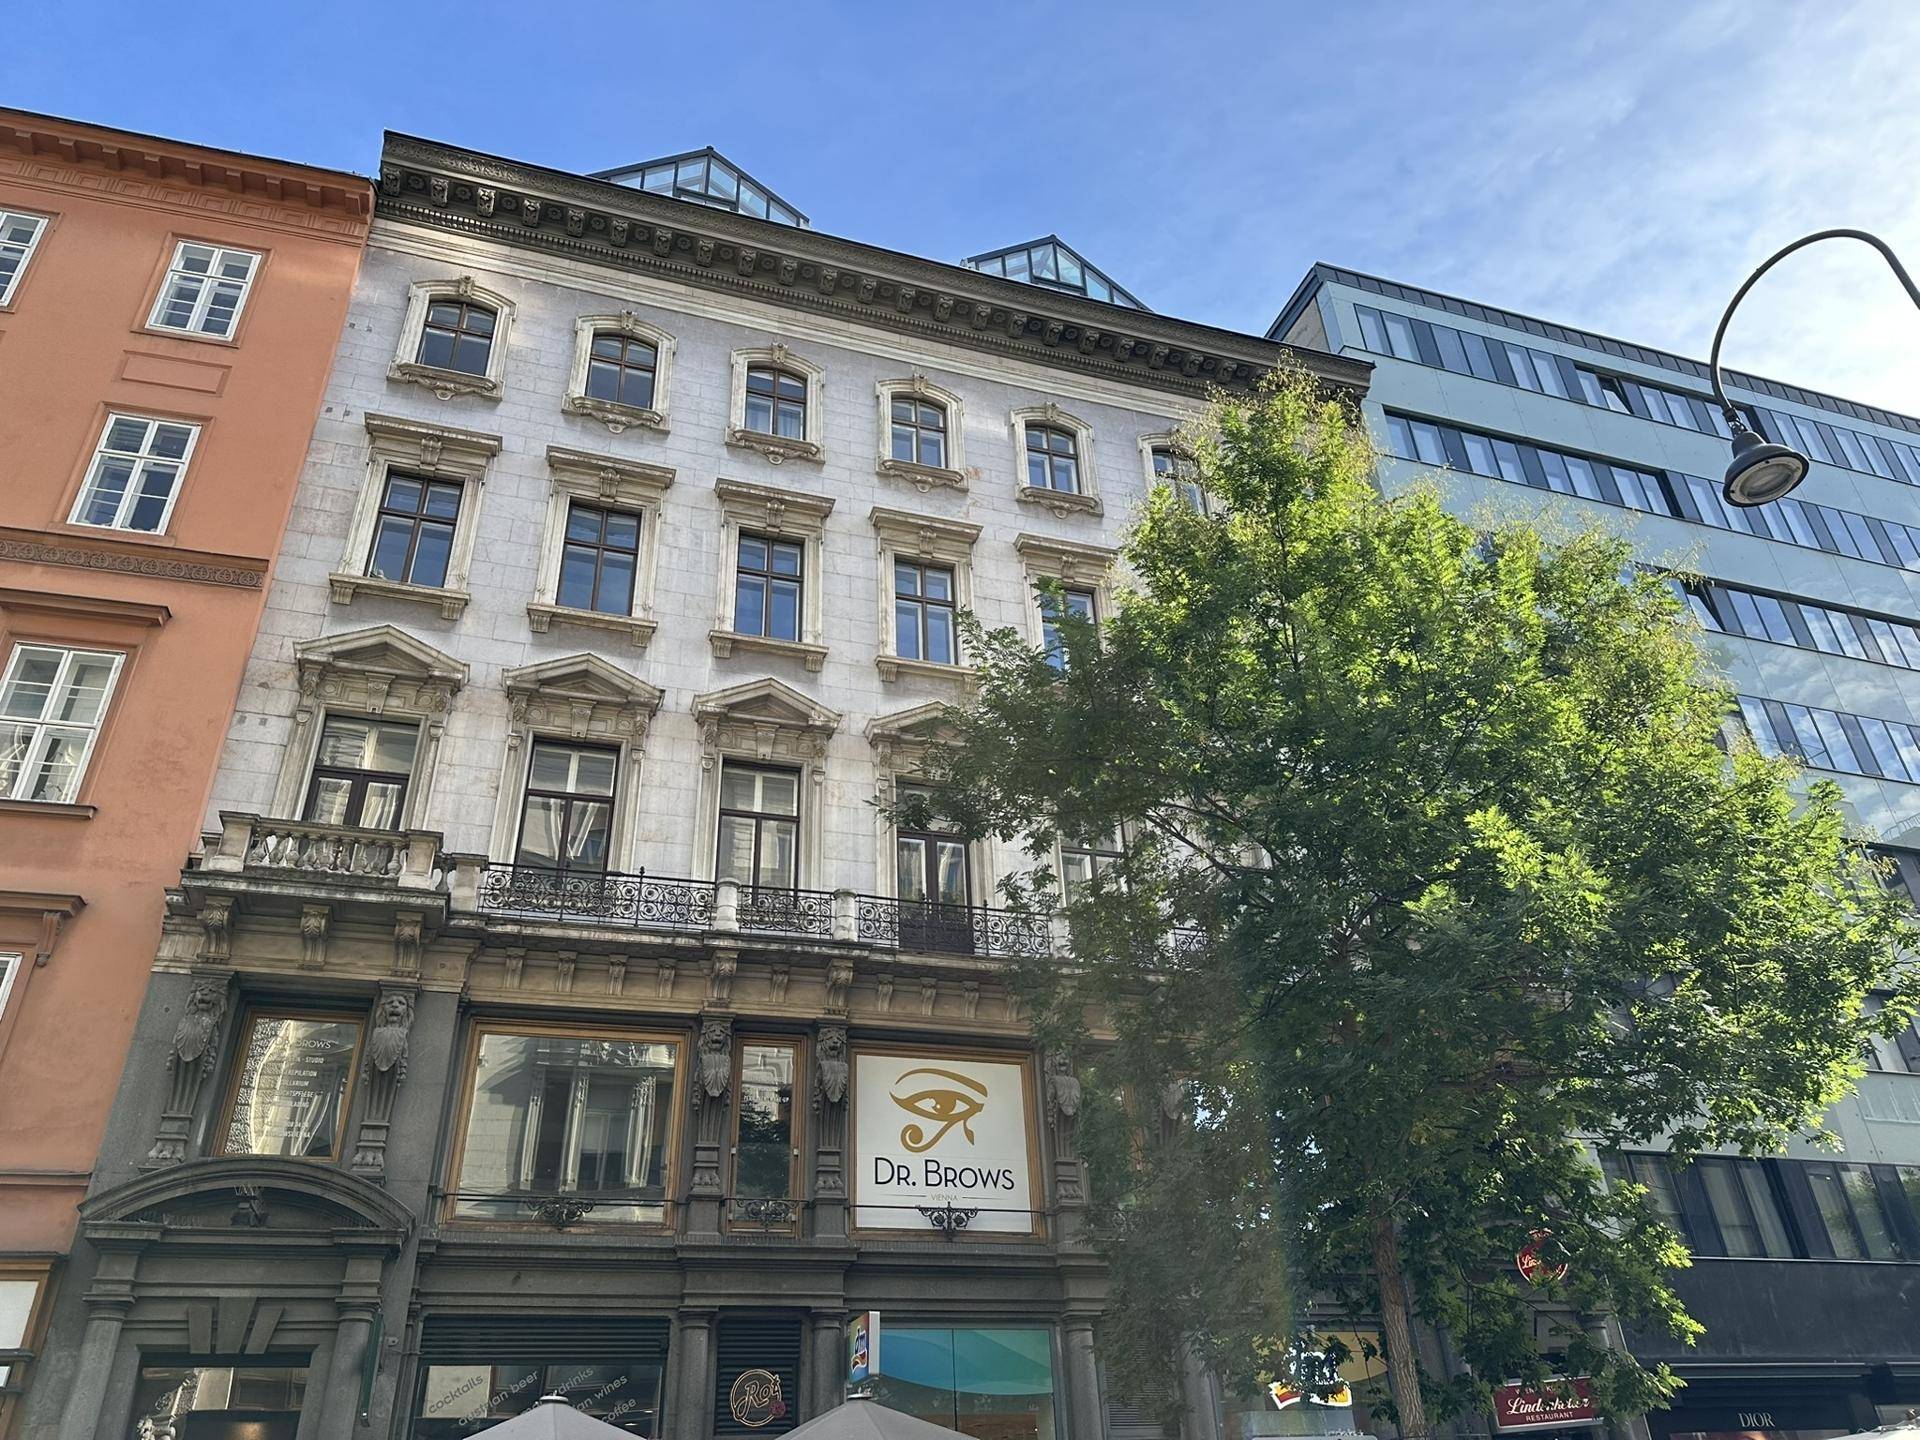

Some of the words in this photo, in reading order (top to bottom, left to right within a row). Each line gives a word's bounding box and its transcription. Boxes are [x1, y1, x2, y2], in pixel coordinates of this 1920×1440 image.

[931, 1193, 959, 1202] VIENNA
[510, 1371, 539, 1395] beer
[559, 1367, 594, 1395] drinks
[594, 1375, 628, 1400] wines
[428, 1375, 484, 1414] cocktails
[601, 1398, 637, 1423] coffee
[1525, 1411, 1573, 1422] RESTAURANT
[1738, 1412, 1775, 1428] DIOR
